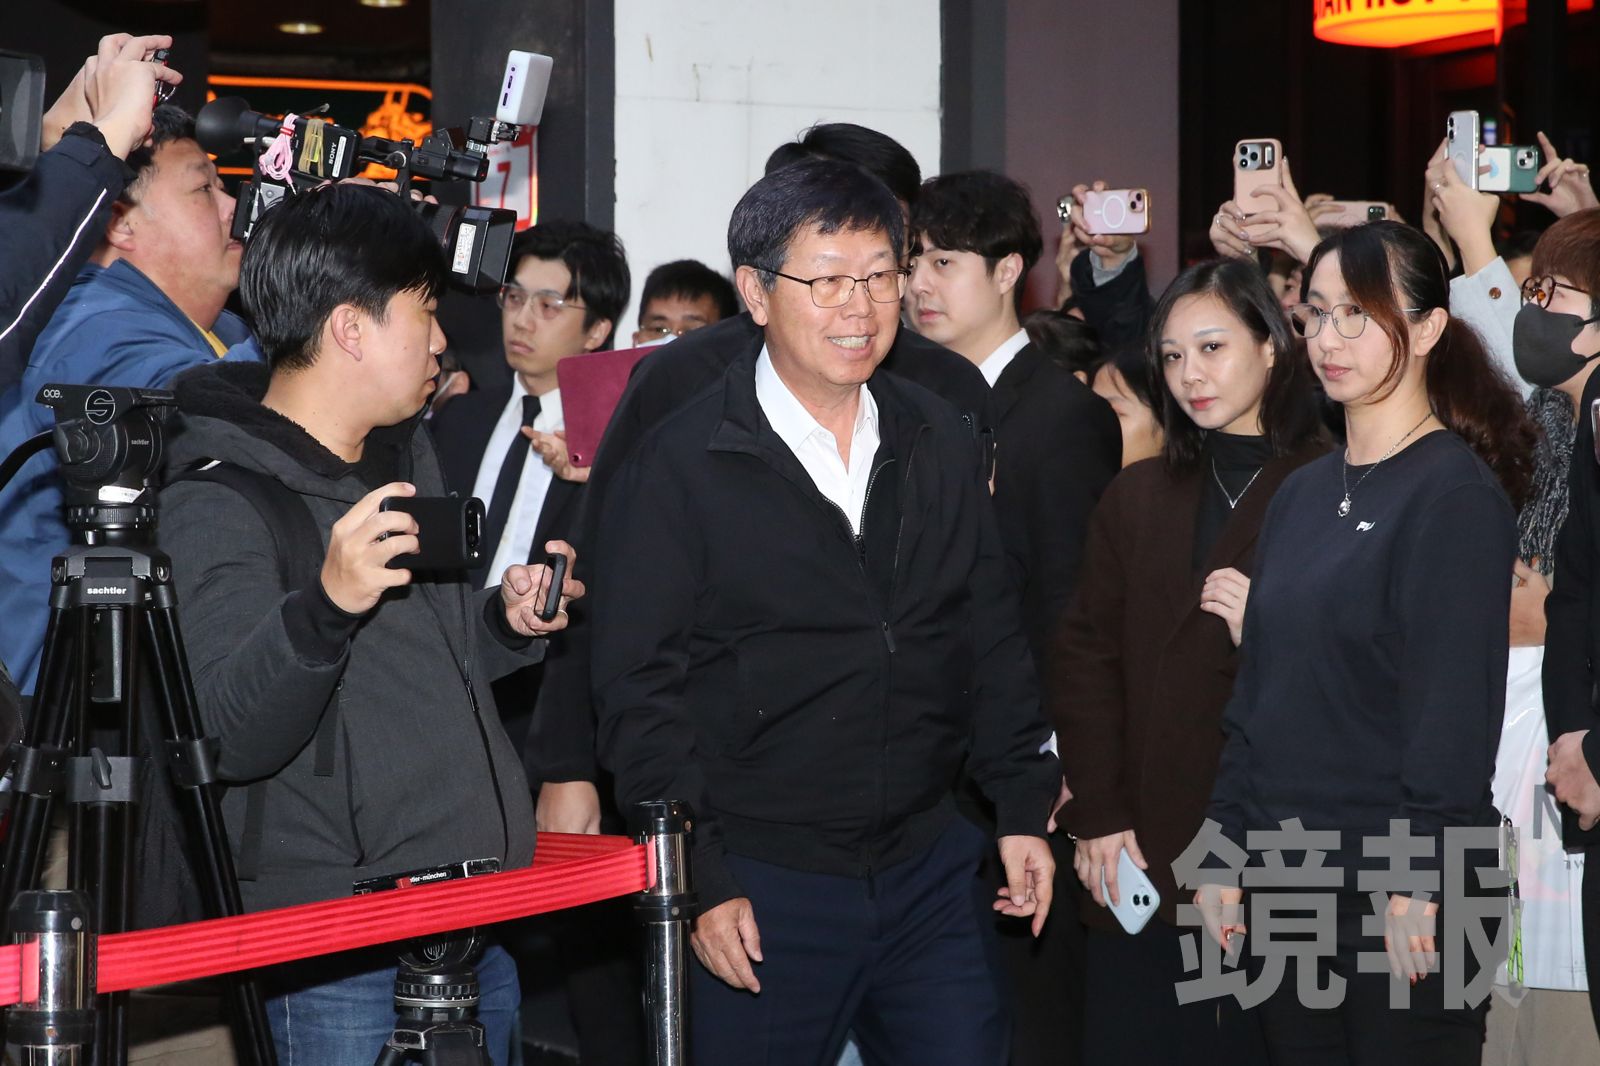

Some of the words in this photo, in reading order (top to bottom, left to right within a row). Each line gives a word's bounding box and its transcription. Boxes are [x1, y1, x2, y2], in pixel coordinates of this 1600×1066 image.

[328, 142, 337, 165] SONY
[87, 586, 127, 595] sachtler
[409, 871, 448, 884] tler-münchen
